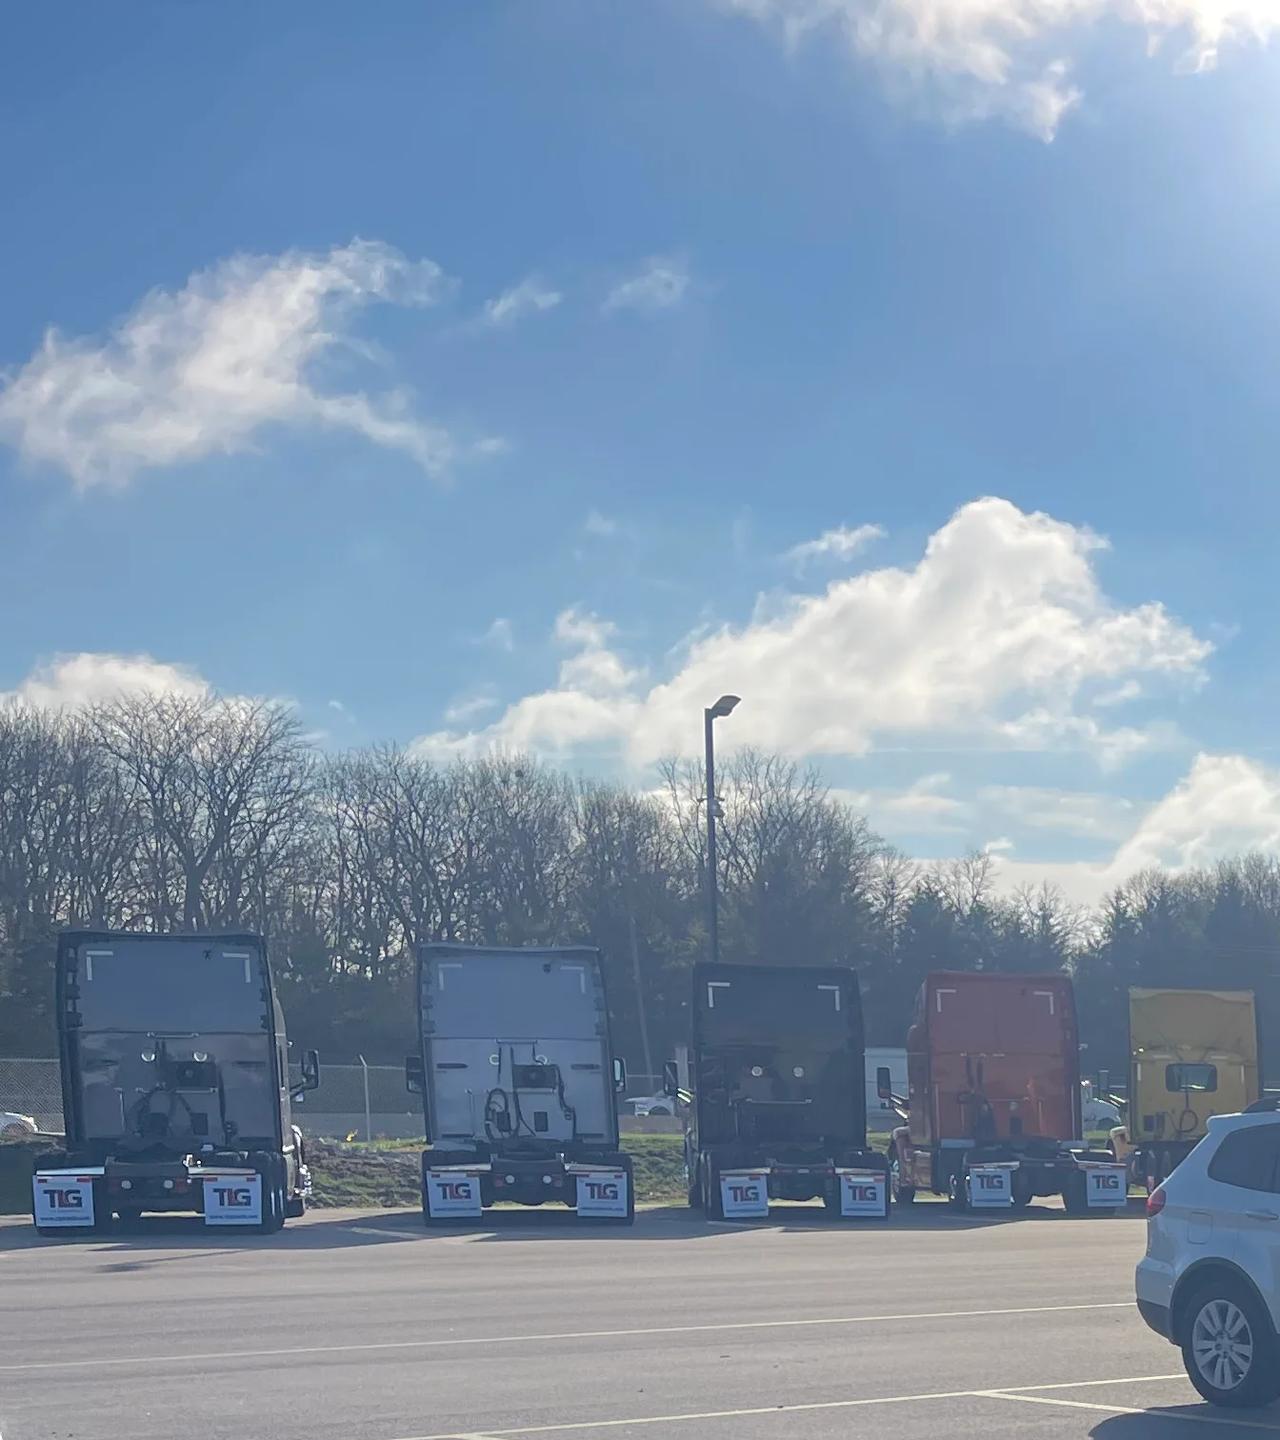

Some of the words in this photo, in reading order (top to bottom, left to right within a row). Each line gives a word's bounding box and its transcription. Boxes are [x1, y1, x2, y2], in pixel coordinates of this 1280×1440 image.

[976, 1174, 1004, 1189] TLG
[1092, 1174, 1119, 1189] TLG
[43, 1189, 82, 1208] TLG
[213, 1188, 252, 1207] TLG
[436, 1182, 472, 1200] TLG
[585, 1182, 618, 1200] TLG
[728, 1185, 760, 1202] TLG
[848, 1185, 877, 1201] TLG
